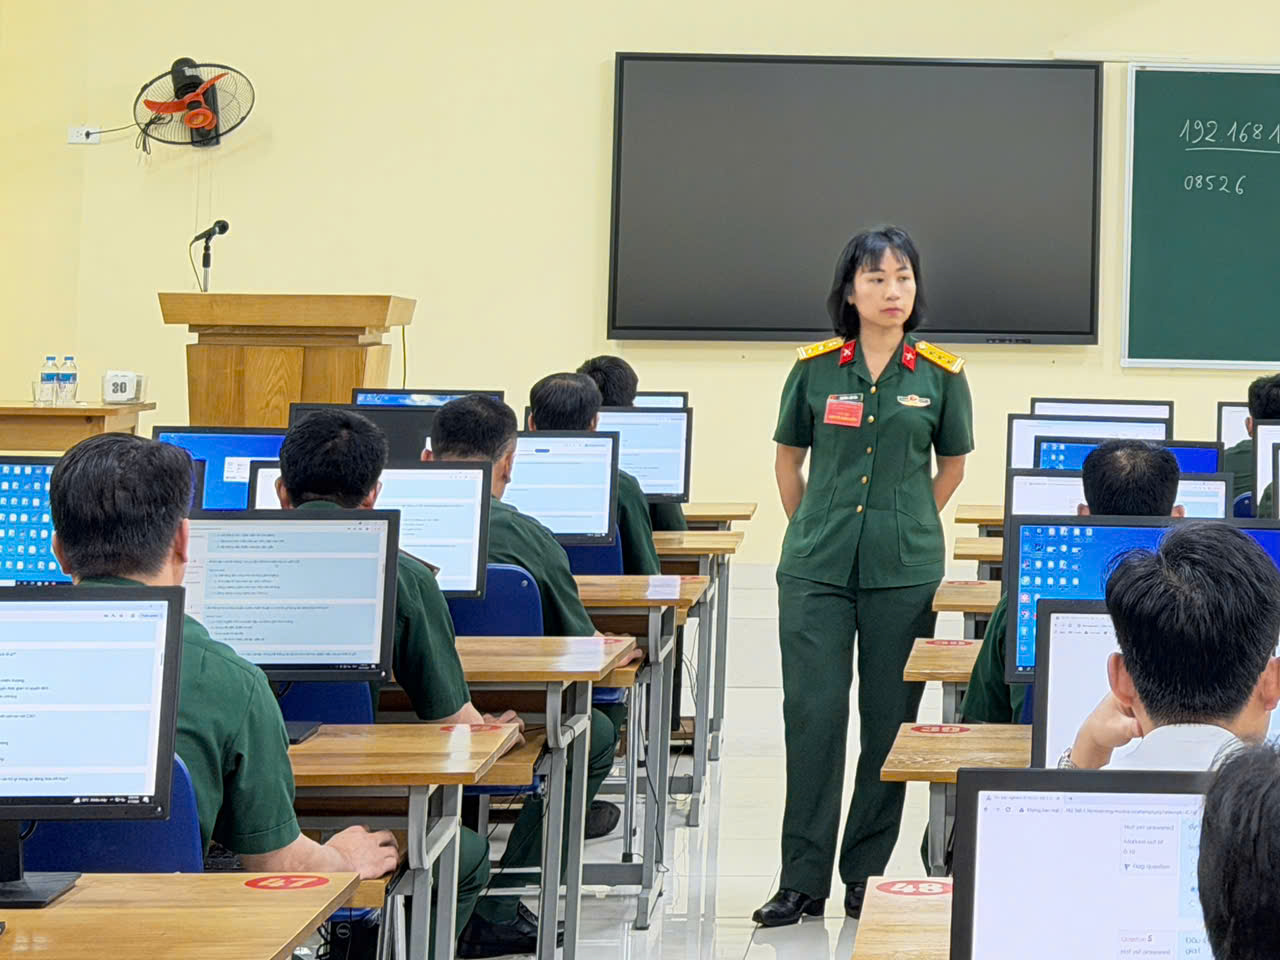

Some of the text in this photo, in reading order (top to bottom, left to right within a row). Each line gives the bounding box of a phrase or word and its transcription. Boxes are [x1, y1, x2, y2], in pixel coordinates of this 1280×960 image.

[1184, 174, 1246, 194] 08526
[111, 381, 128, 394] 30
[890, 882, 944, 893] 48
